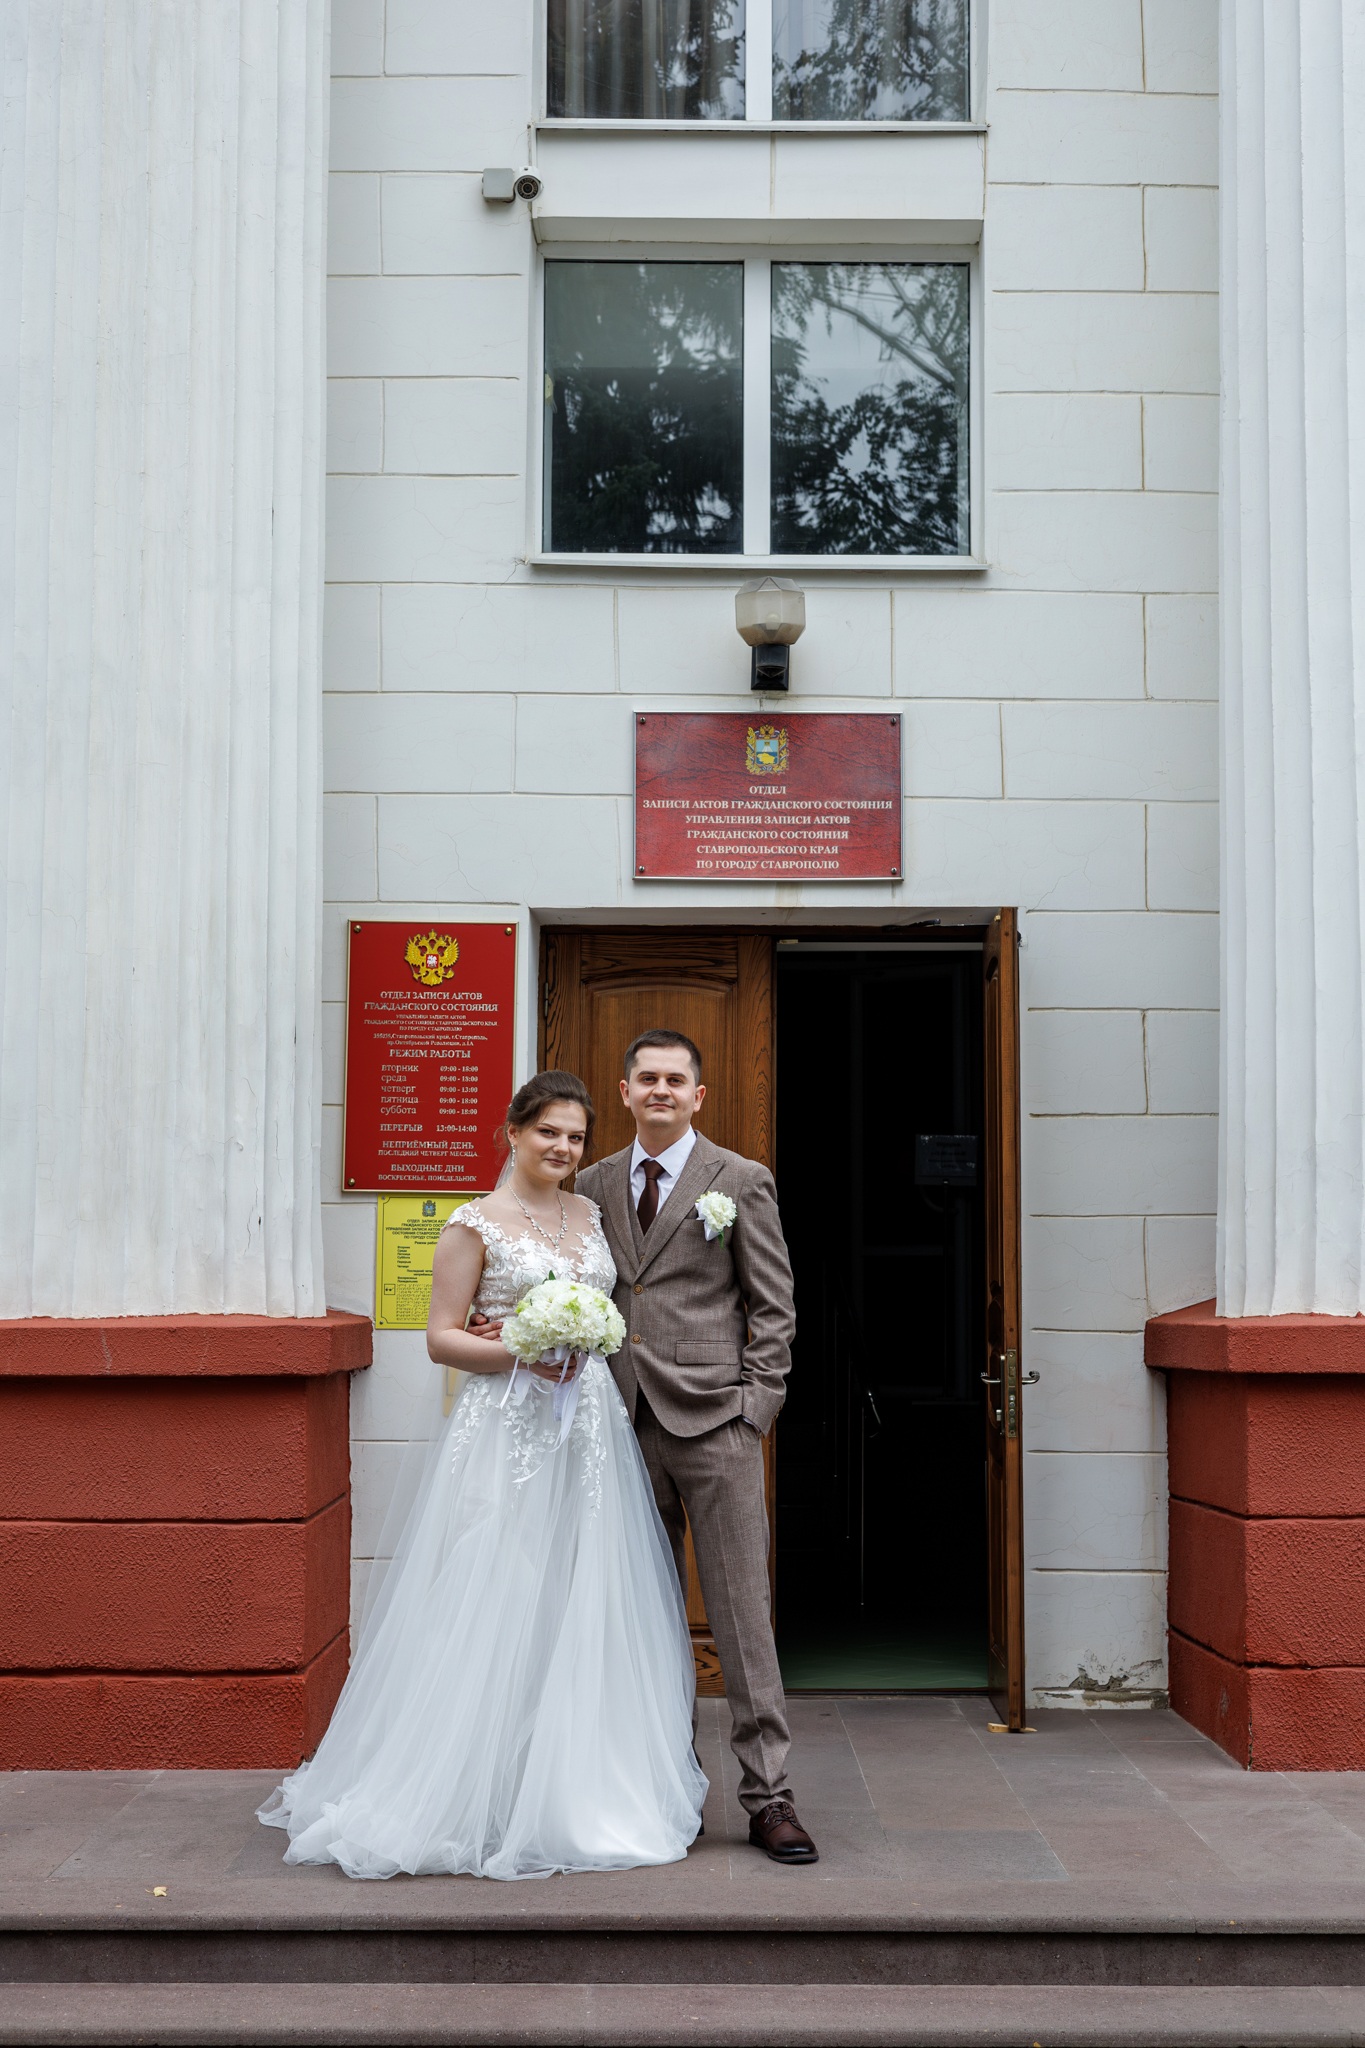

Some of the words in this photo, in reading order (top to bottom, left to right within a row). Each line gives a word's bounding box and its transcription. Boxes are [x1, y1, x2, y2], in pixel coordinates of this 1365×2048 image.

[749, 786, 786, 795] ОТДЕЛ
[643, 800, 690, 810] ЗАПИСИ
[692, 800, 729, 810] АКТОВ
[731, 800, 822, 810] ГРАЖДАНСКОГО
[824, 800, 892, 810] СОСТОЯНИЯ
[685, 816, 762, 825] УПРАВЛЕНИЯ
[764, 816, 811, 825] ЗАПИСИ
[813, 816, 850, 825] АКТОВ
[687, 830, 778, 839] ГРАЖДАНСКОГО
[780, 830, 848, 839] СОСТОЯНИЯ
[697, 845, 807, 854] СТАВРОПОЛЬСКОГО
[809, 845, 839, 854] КРАЯ
[697, 860, 713, 869] ПО
[715, 860, 758, 869] ГОРОДУ
[760, 860, 839, 869] СТАВРОПОЛЮ
[380, 991, 410, 1000] ОТДЕЛ
[413, 991, 449, 1000] ЗАПИСИ
[451, 992, 483, 1000] АКТОВ
[364, 1002, 439, 1011] ГРАЖДАНСКОГО
[441, 1003, 498, 1011] СОСТОЯНИЯ
[389, 1049, 427, 1057] РЕЖИМ
[429, 1050, 471, 1058] РАБОТЫ
[381, 1065, 419, 1074] вторник
[381, 1075, 407, 1083] среда
[381, 1086, 416, 1094] четверг
[381, 1097, 419, 1105] пятница
[380, 1105, 417, 1115] суббота
[380, 1124, 423, 1132] ПЕРЕРЫВ
[382, 1140, 448, 1149] НЕПРИЁМНЫЙ
[450, 1142, 474, 1150] ДЕНЬ
[391, 1164, 443, 1172] ВЫХОДНЫЕ
[444, 1165, 464, 1173] ДНИ
